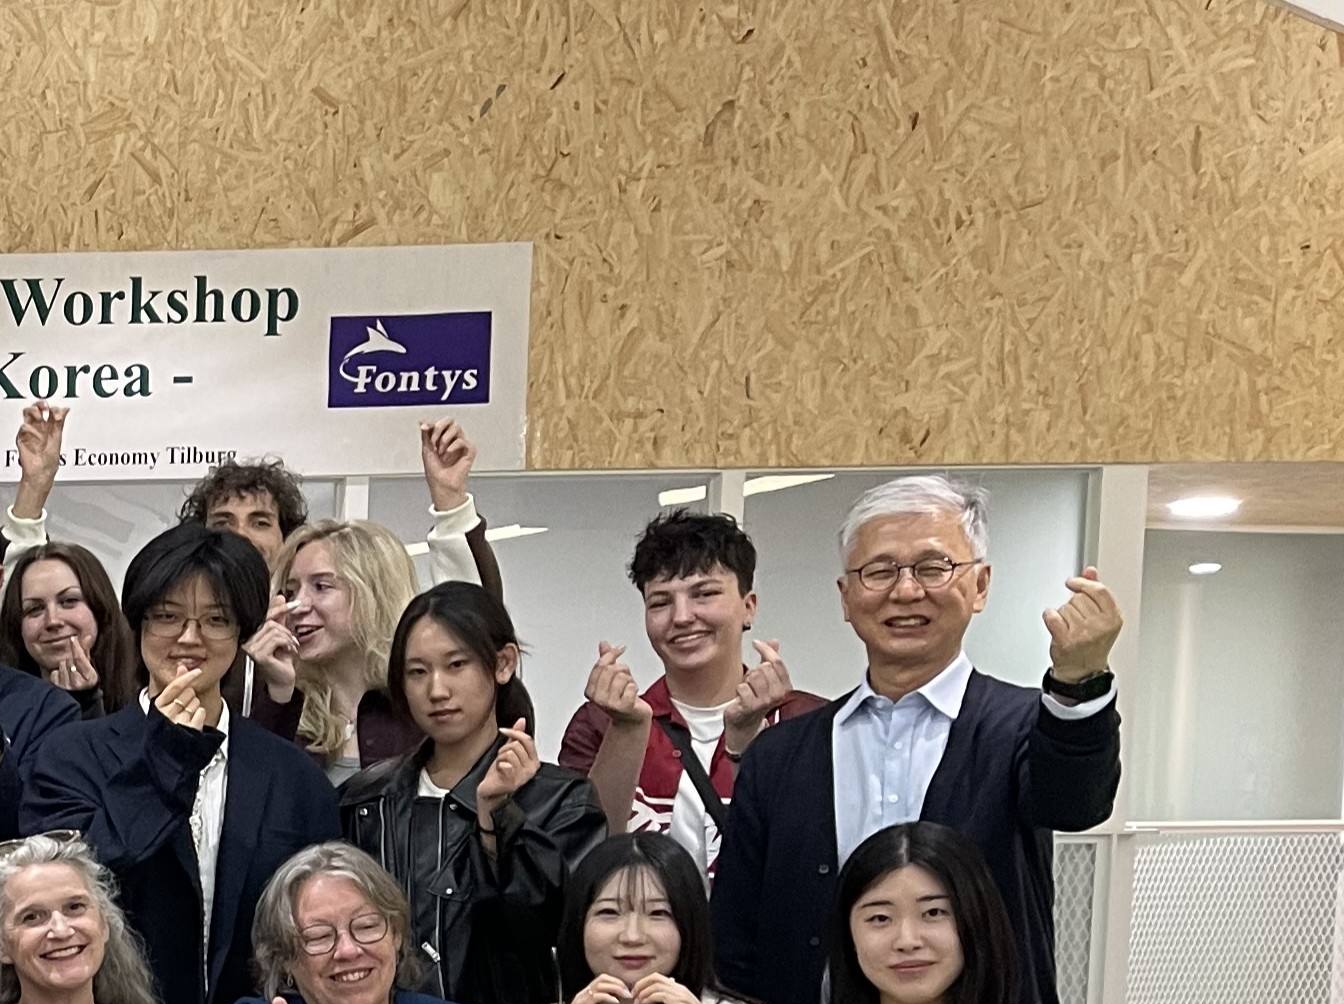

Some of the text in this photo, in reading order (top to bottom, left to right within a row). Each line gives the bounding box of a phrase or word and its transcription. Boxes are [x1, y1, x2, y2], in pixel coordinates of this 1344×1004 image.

[0, 274, 300, 336] Workshop
[352, 365, 478, 401] Fontys
[74, 448, 160, 470] Economy
